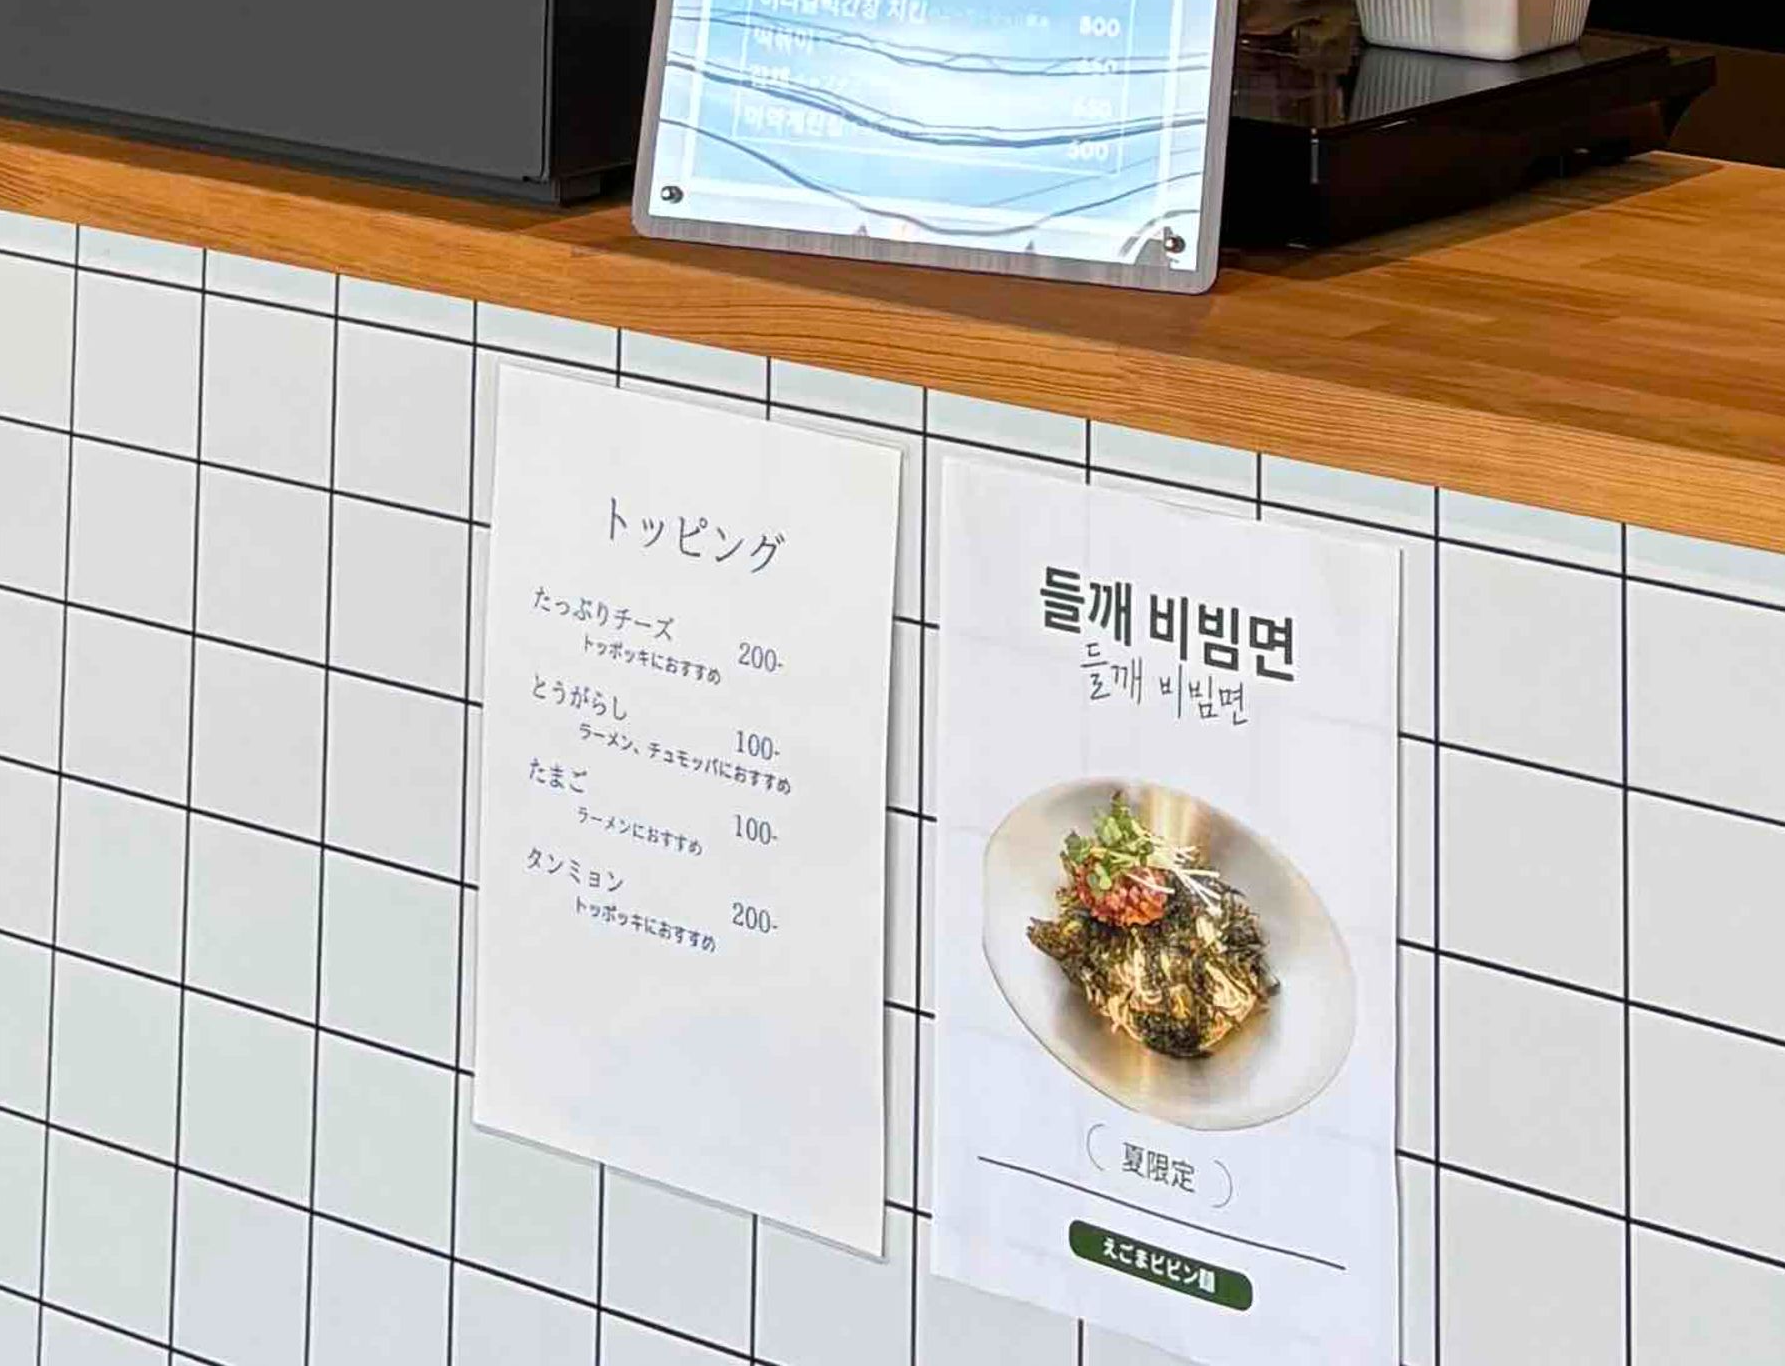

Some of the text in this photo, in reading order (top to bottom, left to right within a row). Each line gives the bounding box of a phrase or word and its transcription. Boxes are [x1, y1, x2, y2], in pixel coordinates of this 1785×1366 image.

[606, 496, 787, 575] トッピング
[1038, 566, 1297, 684] 들깨 비빔면
[531, 672, 629, 722] とうがらし
[1079, 641, 1251, 728] 들깨 비빔면
[528, 757, 589, 795] たまご
[576, 804, 705, 859] ラーメンにおすすめ
[525, 846, 626, 895] タンミョン
[1120, 1139, 1196, 1197] 夏限定
